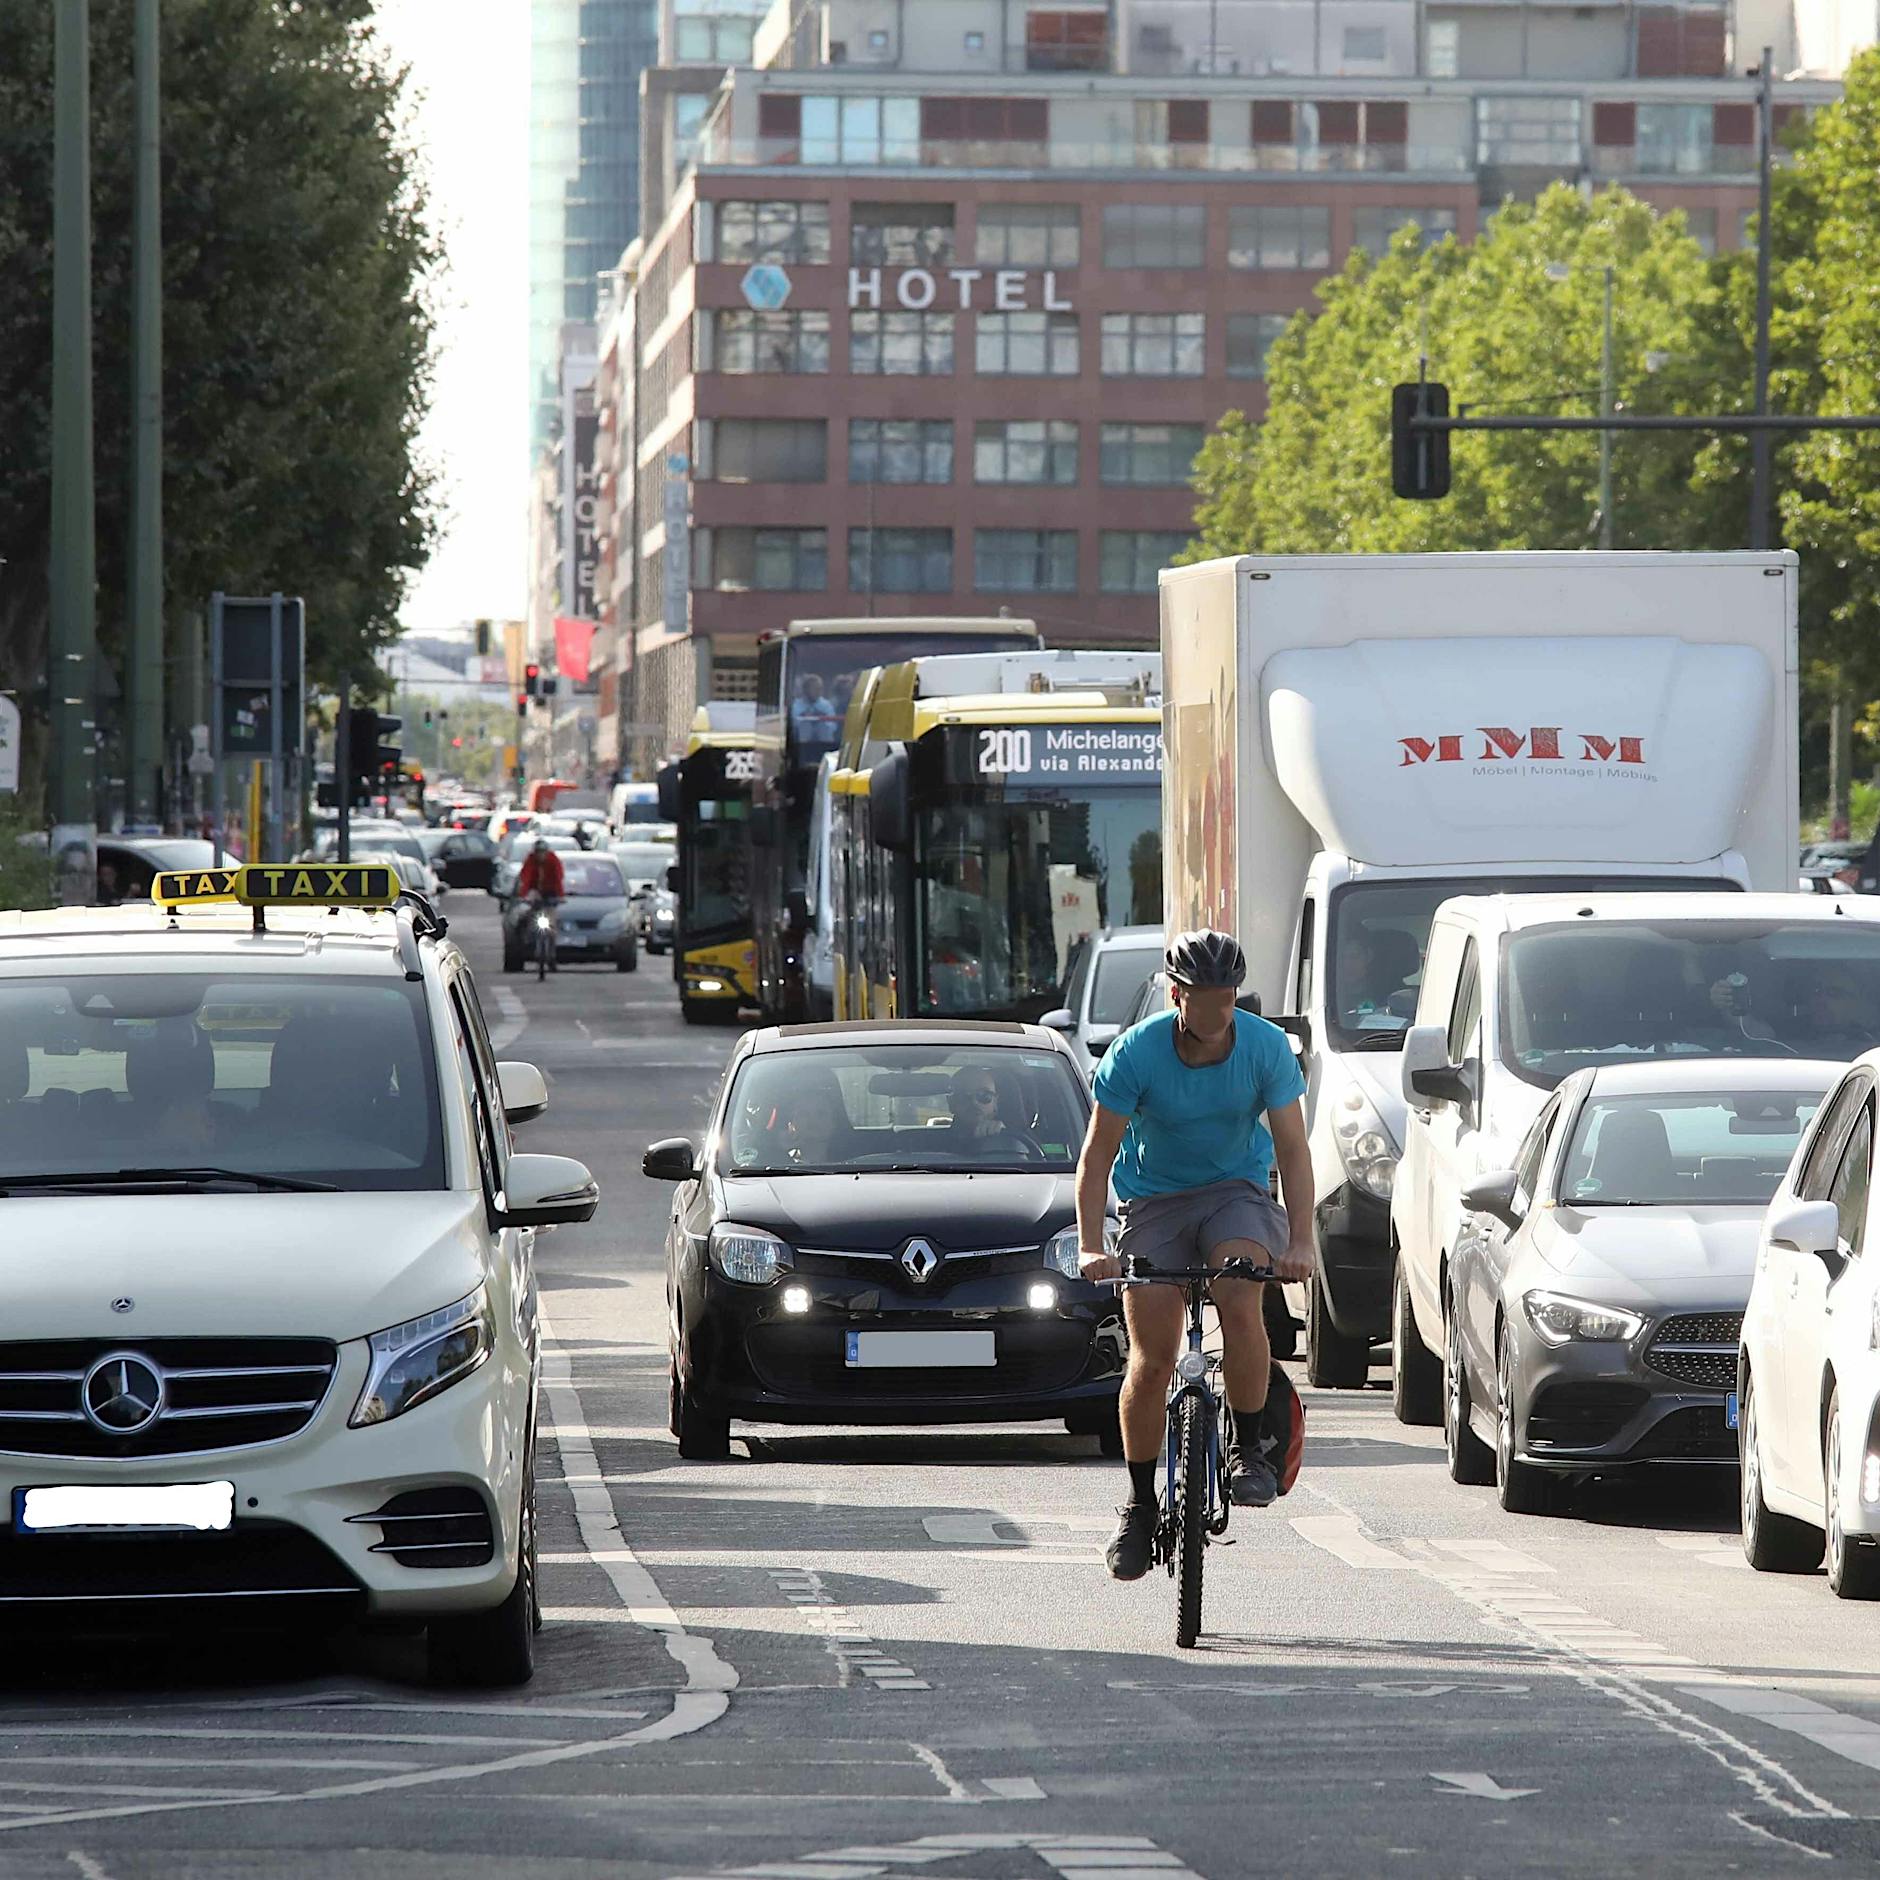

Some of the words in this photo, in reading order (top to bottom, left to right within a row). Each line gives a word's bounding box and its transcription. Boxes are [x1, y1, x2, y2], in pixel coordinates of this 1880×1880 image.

[848, 268, 1073, 310] HOTEL
[979, 729, 1032, 773] 200
[1040, 755, 1069, 771] via
[1530, 766, 1594, 778] Montage
[264, 871, 369, 897] TAXI
